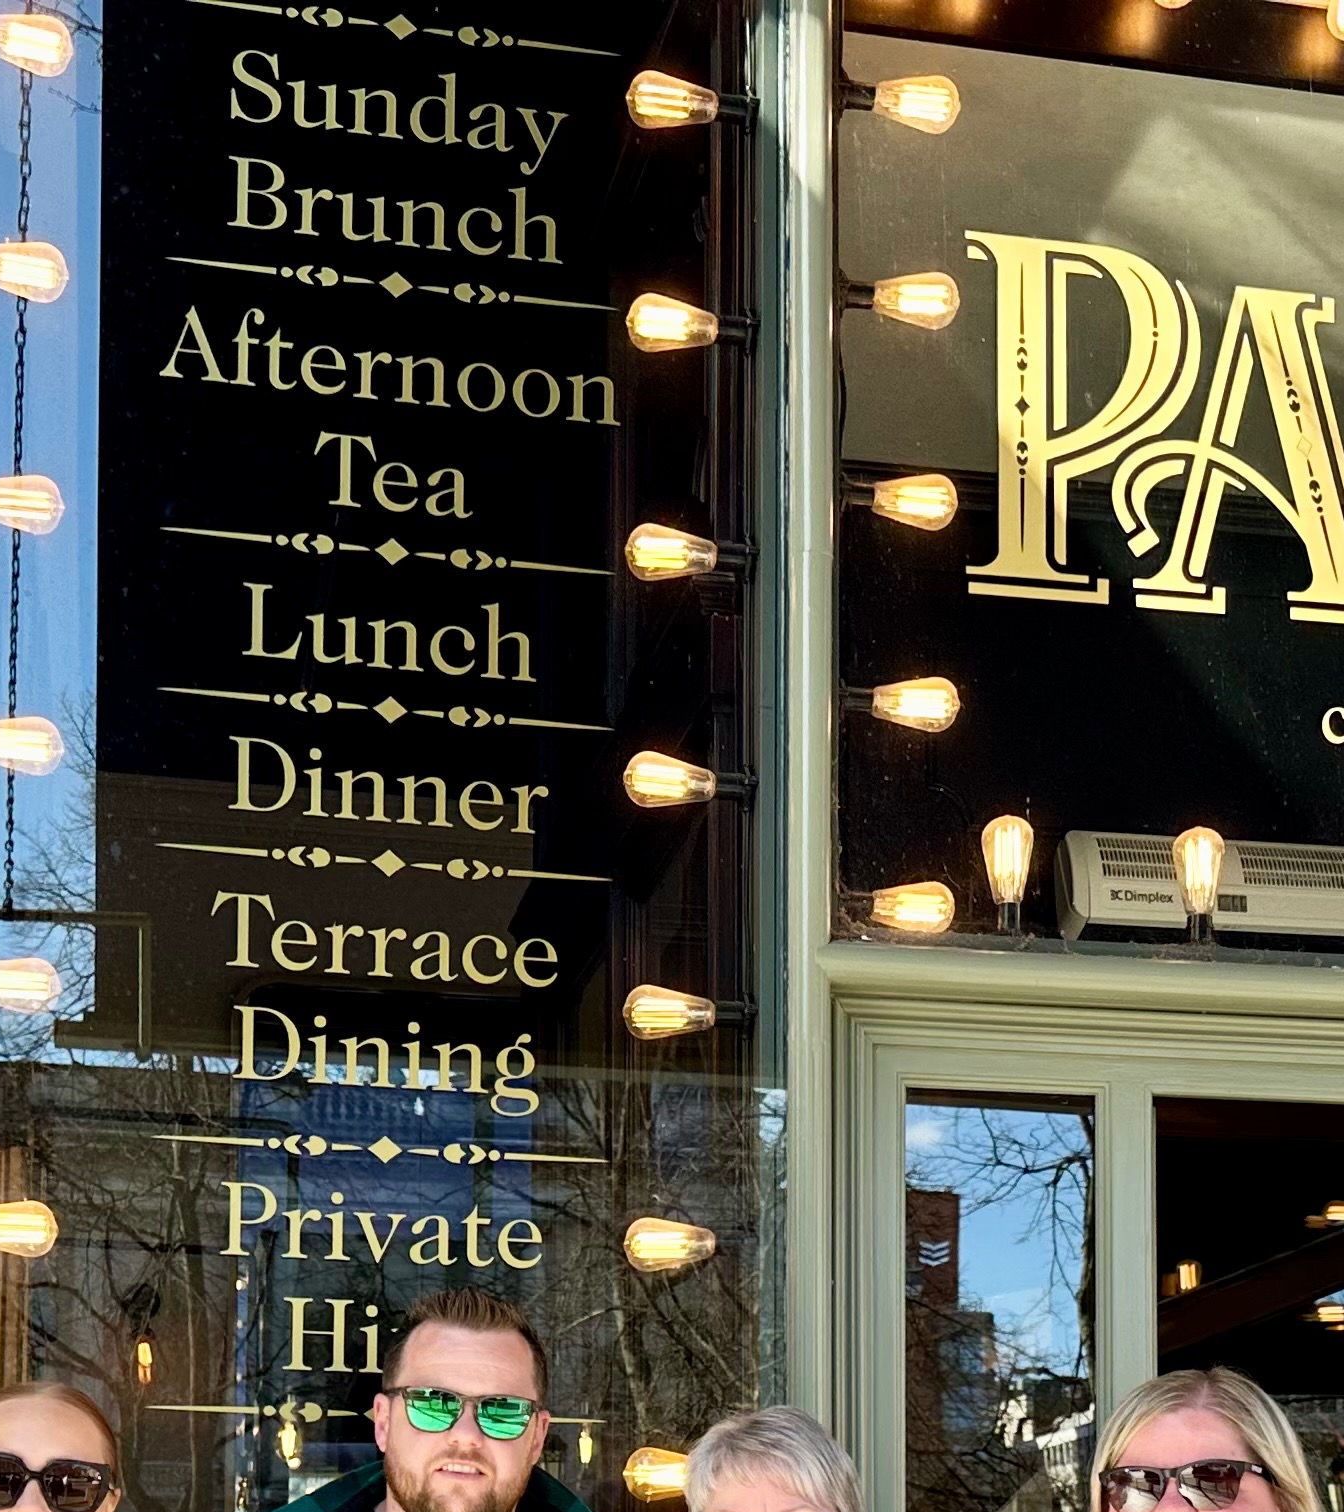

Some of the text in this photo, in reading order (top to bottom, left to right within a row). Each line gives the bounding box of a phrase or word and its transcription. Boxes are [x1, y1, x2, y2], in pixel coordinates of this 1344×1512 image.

[230, 49, 568, 175] Sunday
[227, 155, 563, 264] Brunch
[159, 305, 621, 426] Afternoon
[314, 430, 473, 519] Tea
[242, 582, 536, 683] Lunch
[228, 736, 550, 835] Dinner
[210, 890, 559, 988] Terrace
[1124, 889, 1174, 904] Dimplex
[232, 1005, 541, 1118] Dining
[220, 1181, 544, 1269] Private
[282, 1297, 399, 1373] Hi
